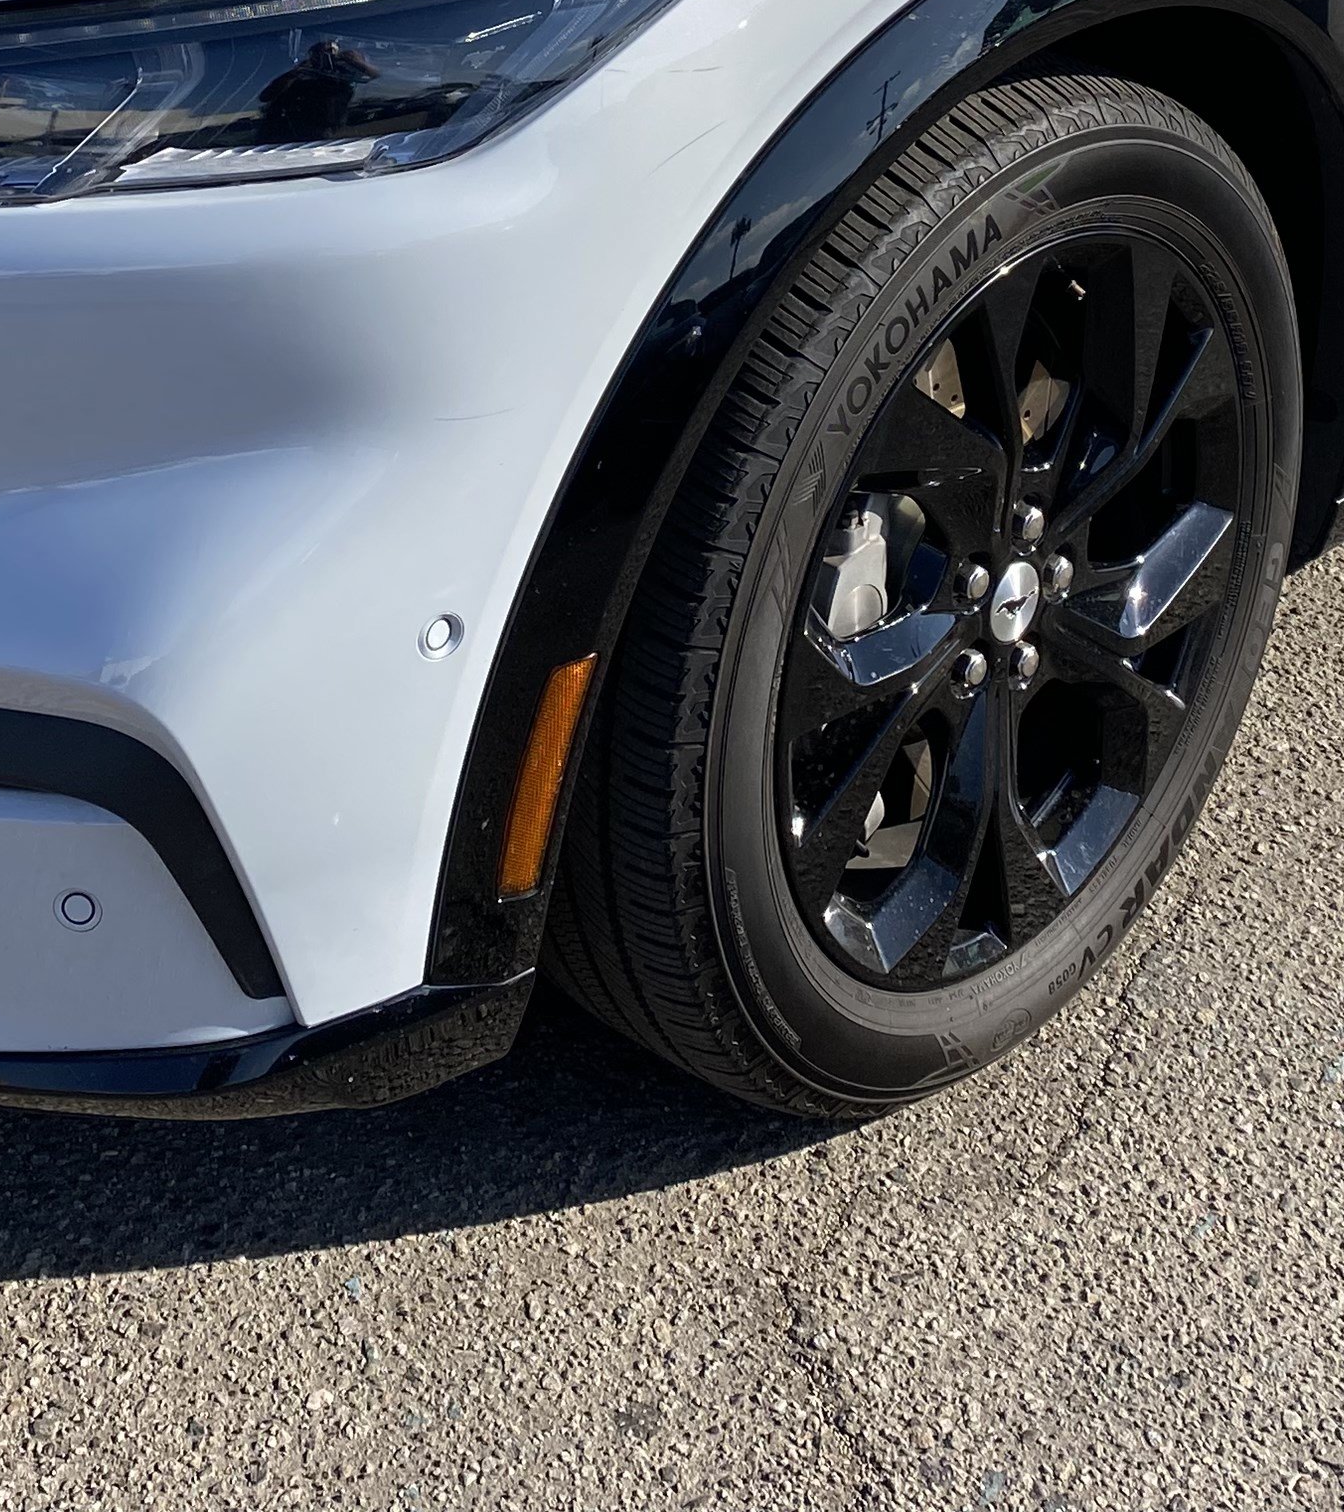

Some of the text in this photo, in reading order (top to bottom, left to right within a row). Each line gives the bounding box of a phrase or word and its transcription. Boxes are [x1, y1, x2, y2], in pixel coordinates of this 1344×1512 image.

[827, 214, 1002, 436] YOKOHAMA
[971, 962, 1021, 995] YOKOHAMA
[1076, 924, 1114, 980] CV
